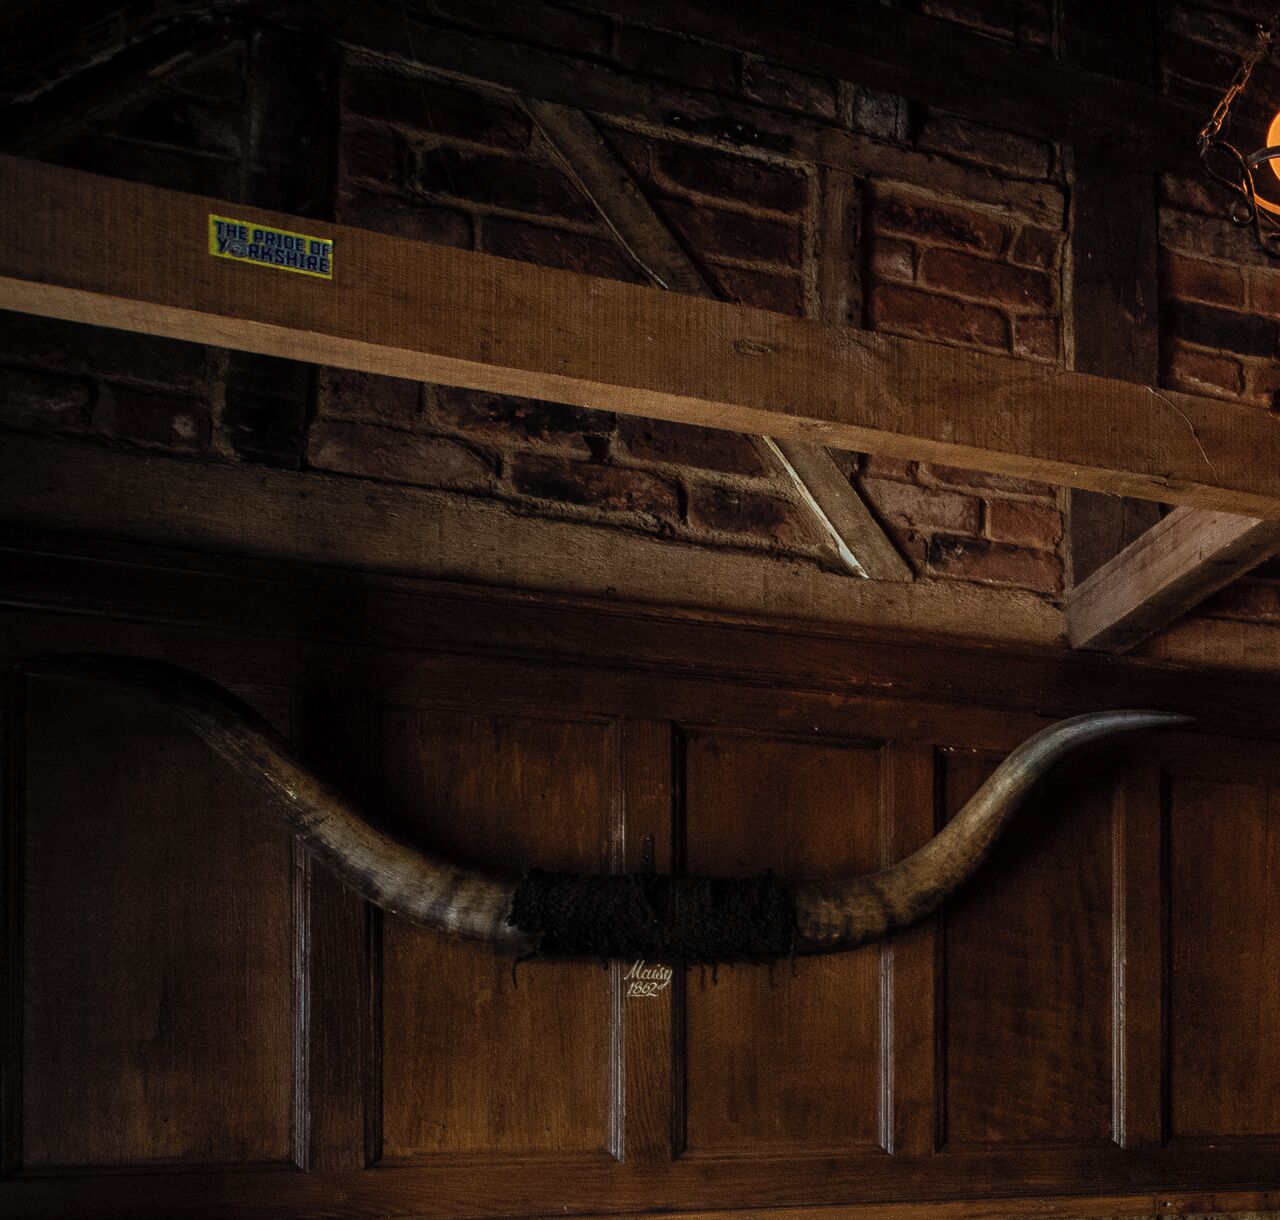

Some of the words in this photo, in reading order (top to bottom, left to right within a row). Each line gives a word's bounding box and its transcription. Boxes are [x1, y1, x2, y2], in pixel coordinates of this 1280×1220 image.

[214, 220, 248, 240] THE
[253, 229, 306, 251] PRIDE
[309, 241, 333, 256] OF
[216, 236, 330, 273] YORKSHIRE
[623, 960, 673, 990] Maisy
[627, 981, 658, 997] 1862
